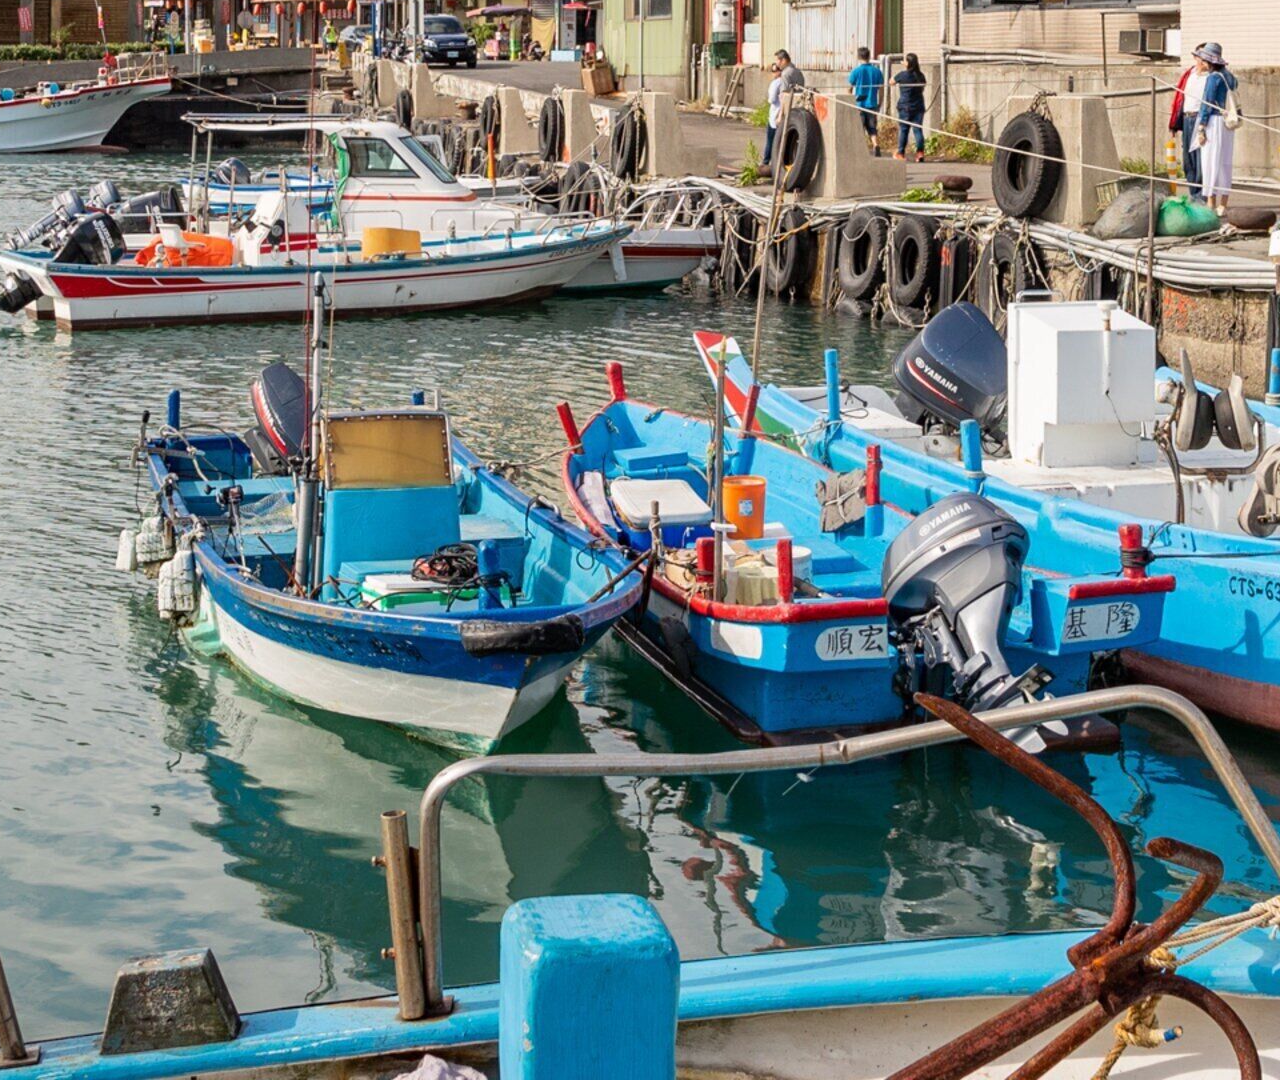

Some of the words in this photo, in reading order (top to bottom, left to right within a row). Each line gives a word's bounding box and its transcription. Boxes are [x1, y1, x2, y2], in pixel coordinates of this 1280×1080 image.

[923, 366, 959, 394] YAMAHA
[928, 502, 972, 528] YAMAHA
[1064, 601, 1137, 640] 基隆
[827, 624, 884, 655] 順宏
